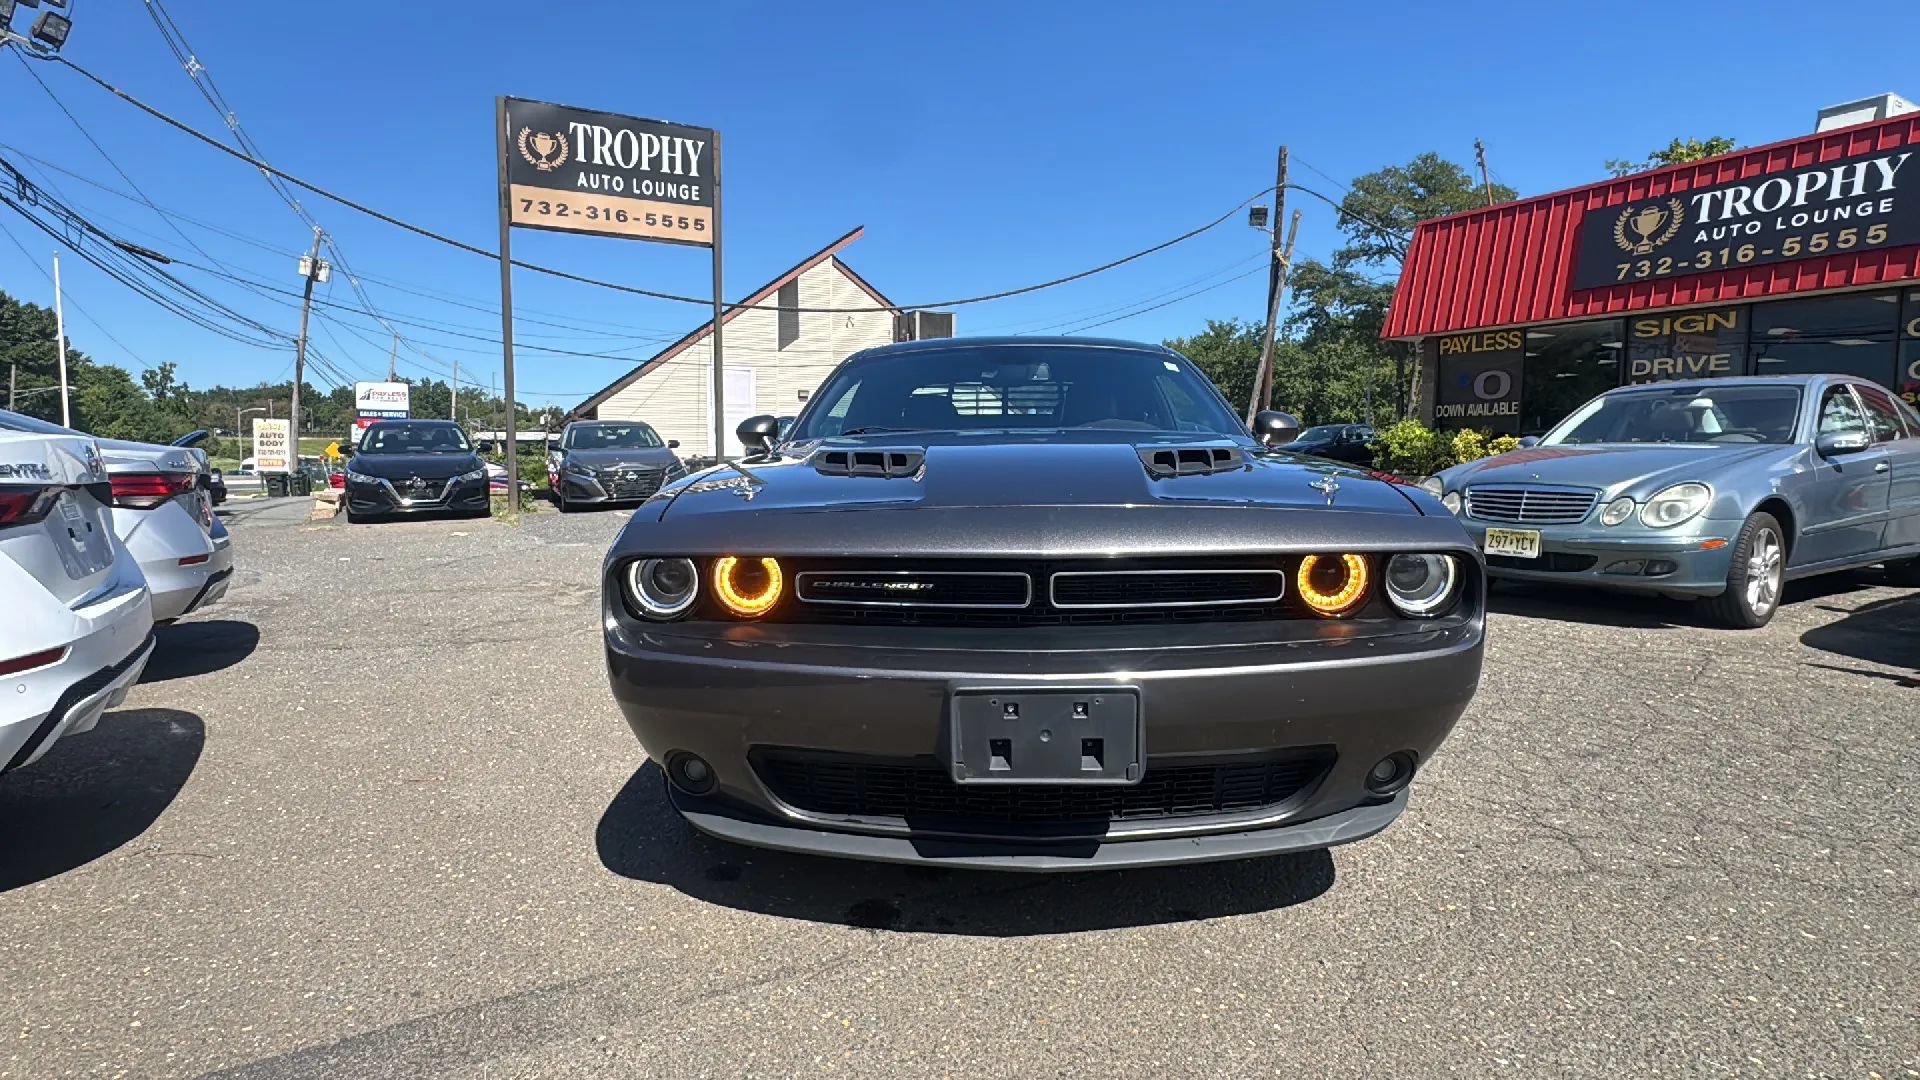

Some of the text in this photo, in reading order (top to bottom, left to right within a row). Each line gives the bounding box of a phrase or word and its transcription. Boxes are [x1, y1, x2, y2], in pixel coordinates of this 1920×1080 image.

[569, 121, 705, 177] TROPHY
[577, 171, 700, 201] AUTO LOUNGE
[1690, 152, 1913, 225] TROPHY
[520, 198, 706, 232] 732-316-5555
[1693, 197, 1895, 244] AUTO LOUNGE
[1615, 223, 1889, 281] 732-316-5555
[1634, 310, 1737, 338] SIGN
[1439, 331, 1522, 355] PAYLESS
[1631, 353, 1731, 376] DRIVE
[1435, 401, 1519, 418] DOWN AVAILABLE
[0, 463, 51, 480] ENTRA
[812, 580, 935, 590] CHALLENGER
